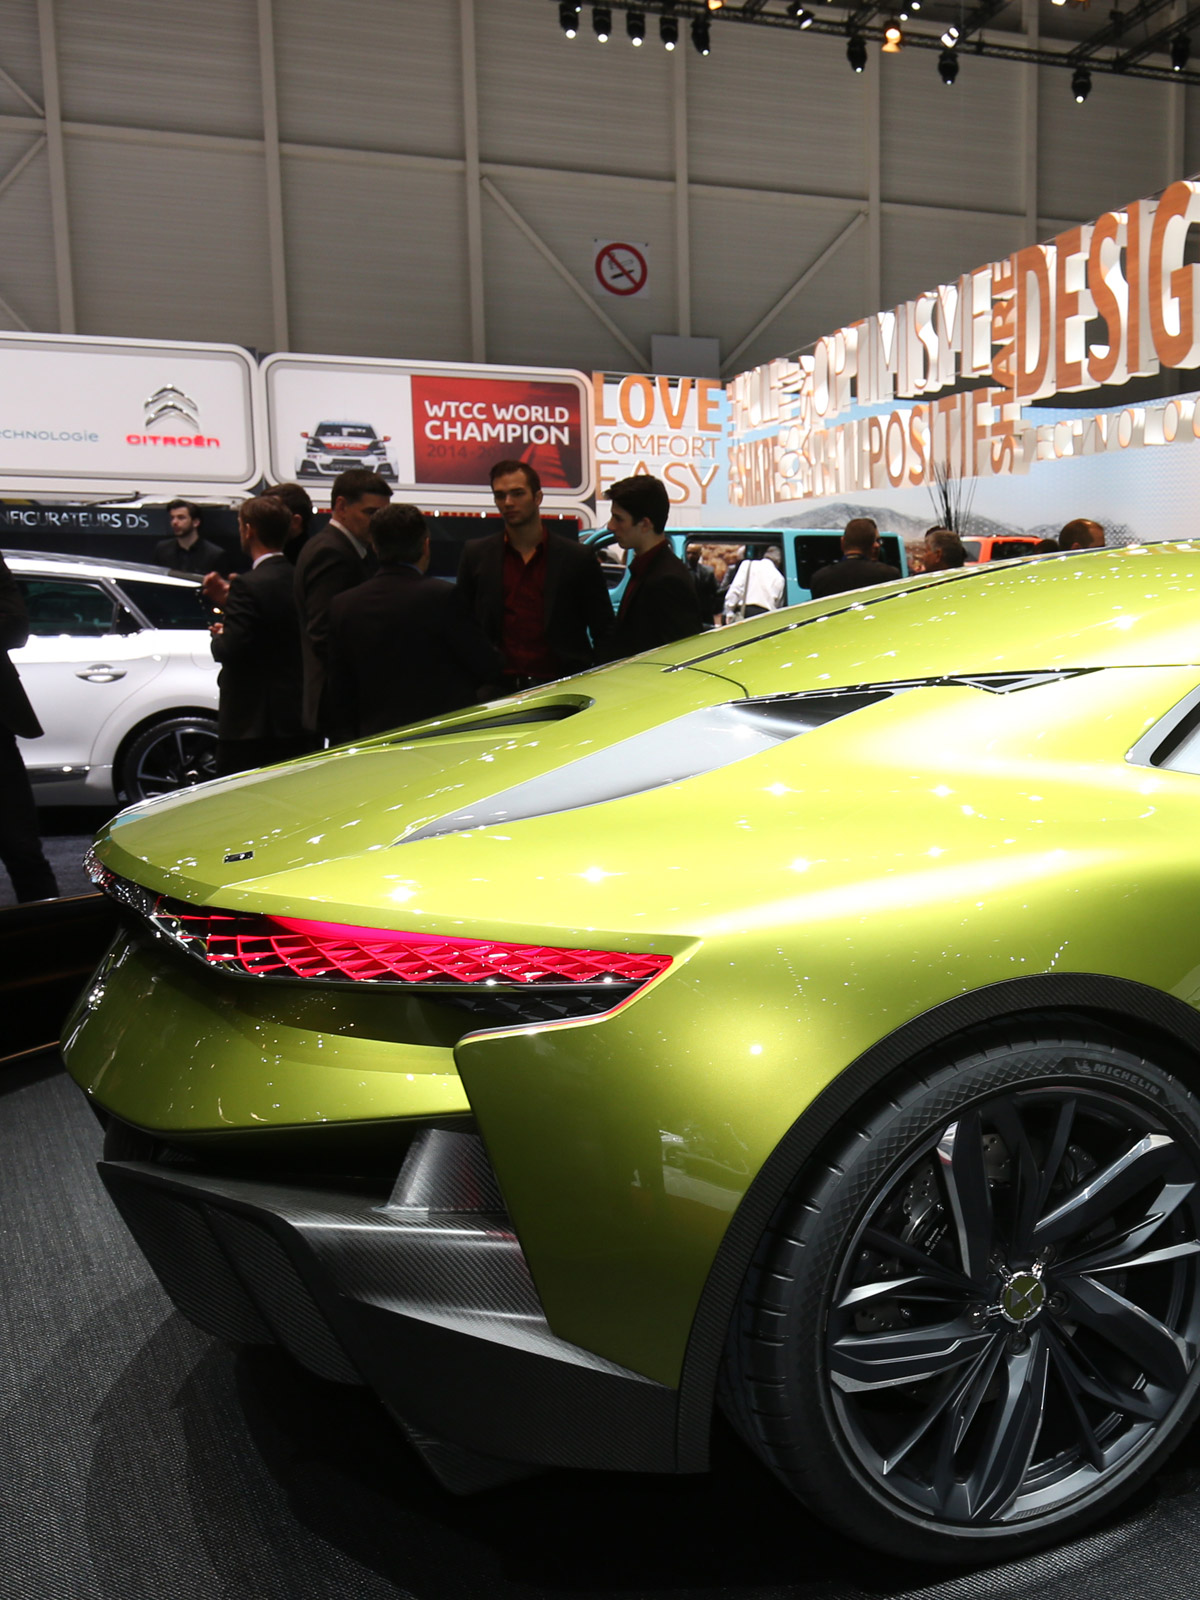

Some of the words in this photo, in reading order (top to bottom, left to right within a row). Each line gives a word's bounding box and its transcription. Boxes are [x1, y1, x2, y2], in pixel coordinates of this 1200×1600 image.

[813, 263, 993, 419] OPTIMISME
[424, 400, 487, 421] WTCC
[492, 403, 570, 424] WORLD
[593, 371, 723, 432] LOVE
[424, 420, 571, 446] CHAMPION
[594, 431, 721, 460] COMFORT
[868, 386, 993, 488] POSITIF
[426, 443, 468, 459] 2014
[126, 513, 149, 529] DS
[1093, 1063, 1161, 1096] MICHELIN
